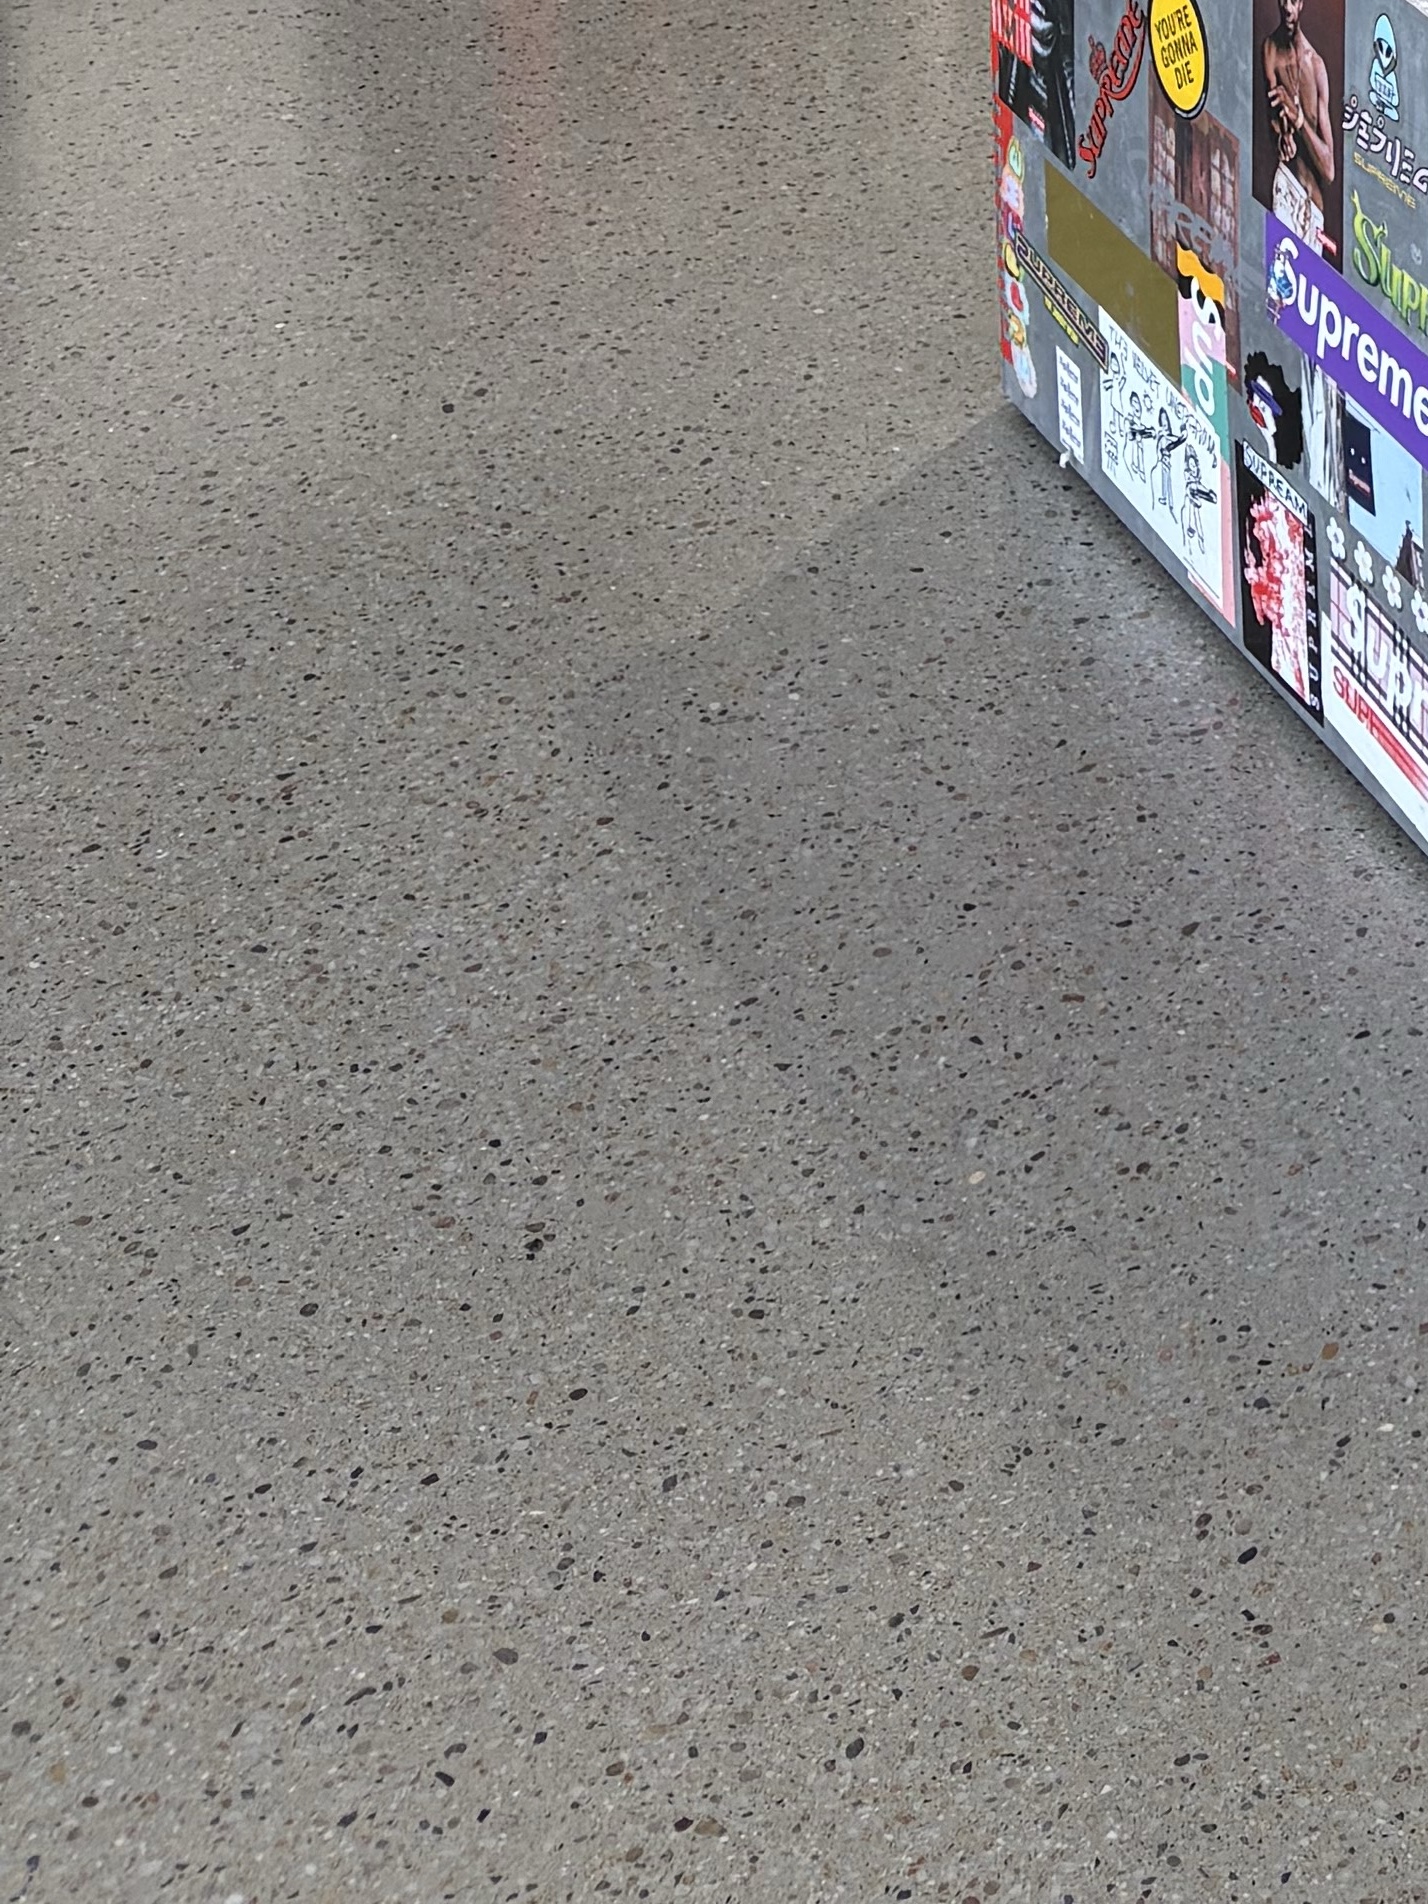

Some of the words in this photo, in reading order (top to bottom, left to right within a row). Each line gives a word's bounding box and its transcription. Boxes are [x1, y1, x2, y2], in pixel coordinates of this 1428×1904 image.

[1153, 3, 1193, 43] YOU'RE
[1159, 32, 1199, 70] GONNA
[1173, 59, 1195, 91] DIE
